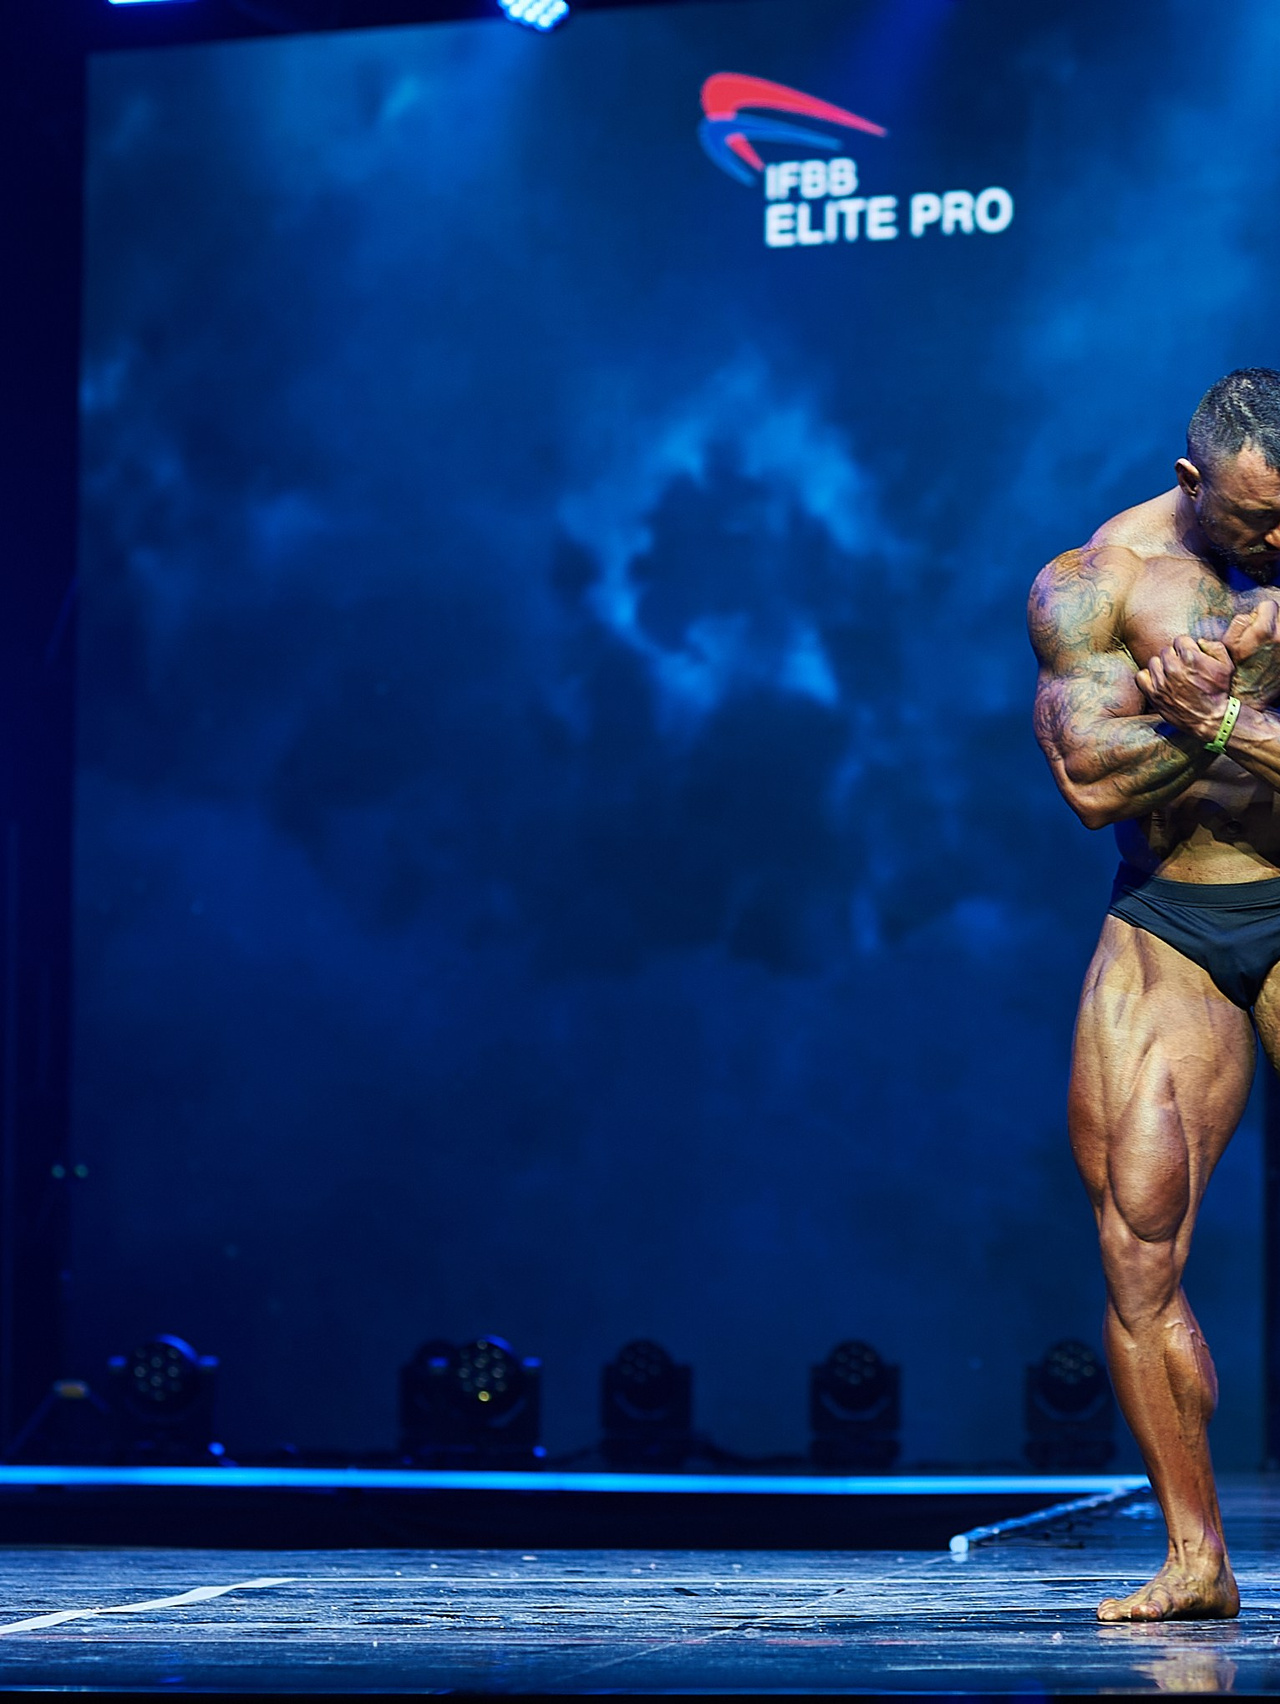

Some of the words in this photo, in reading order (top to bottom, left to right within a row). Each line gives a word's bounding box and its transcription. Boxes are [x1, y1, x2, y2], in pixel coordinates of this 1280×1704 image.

[765, 158, 858, 200] IFBB
[764, 196, 899, 247] ELITE
[909, 187, 1014, 238] PRO
